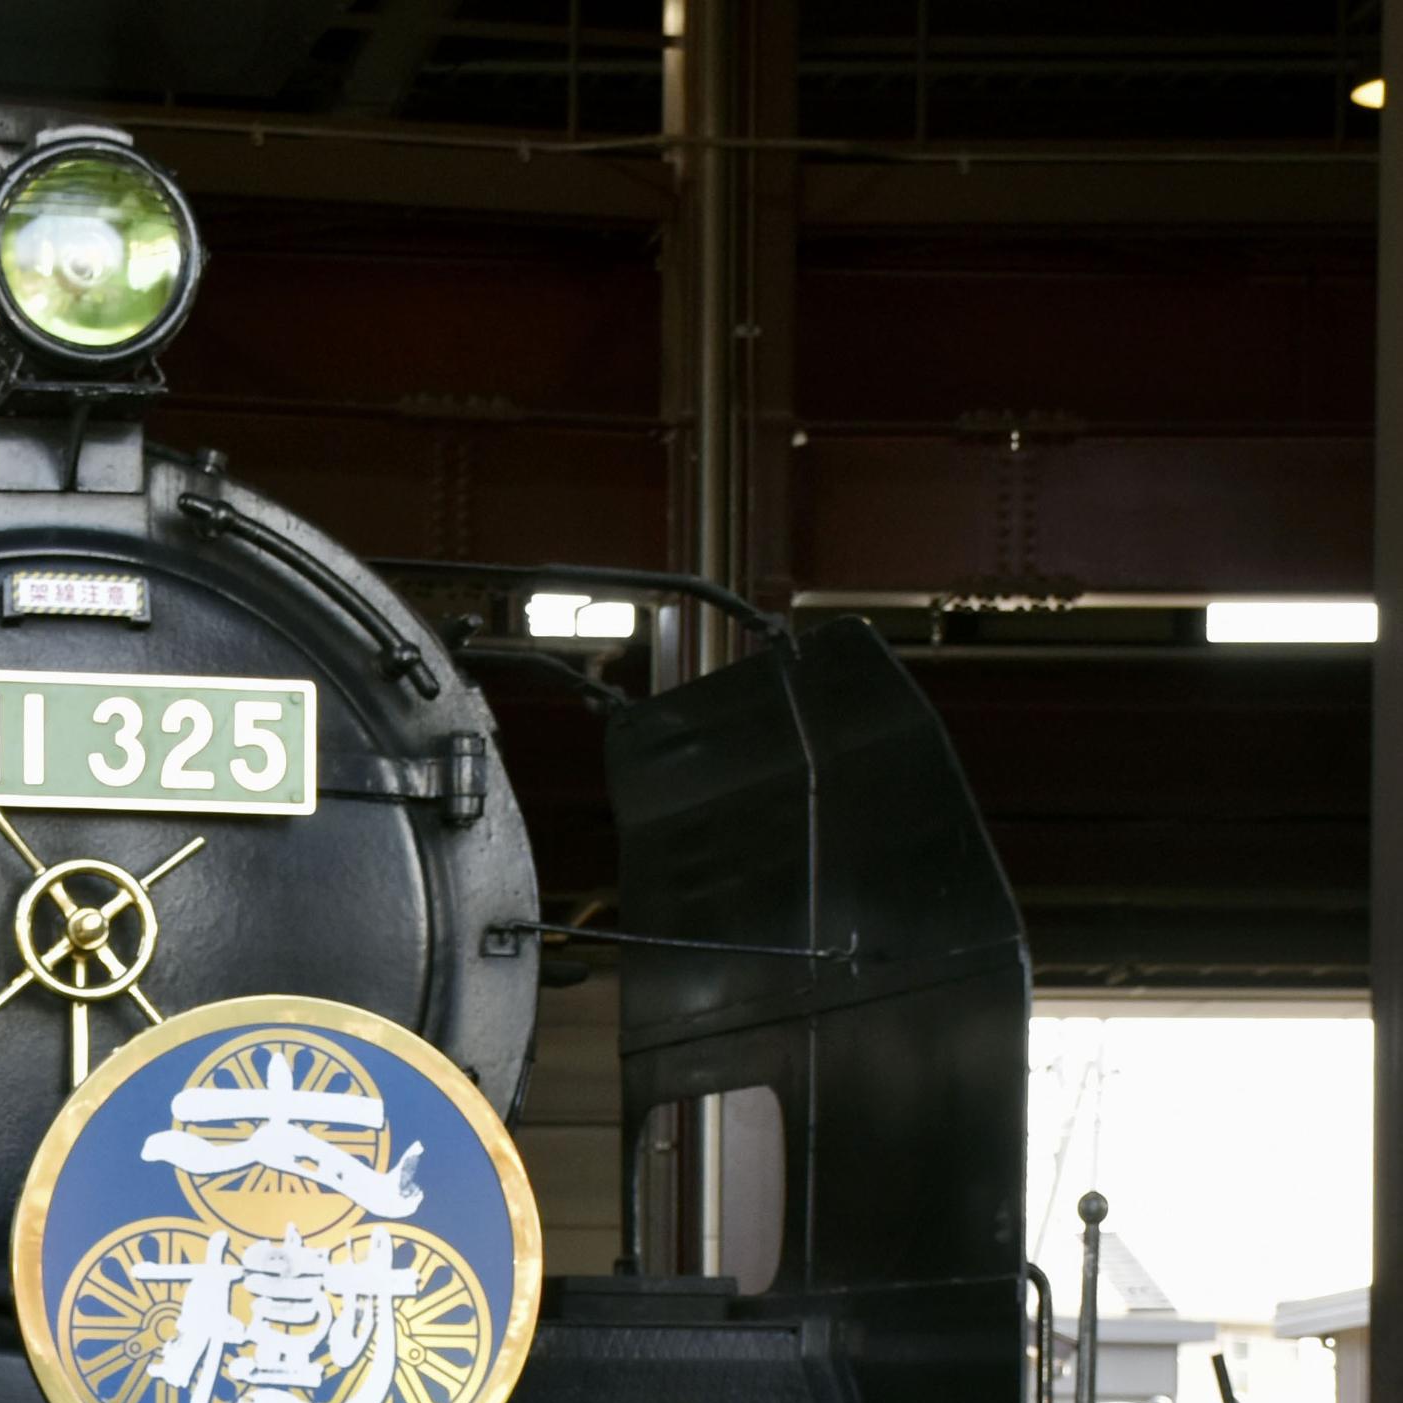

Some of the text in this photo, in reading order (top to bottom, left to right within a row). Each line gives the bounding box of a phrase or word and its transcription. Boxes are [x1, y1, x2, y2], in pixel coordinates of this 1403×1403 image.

[29, 583, 125, 605] 架線注意
[88, 697, 287, 792] 325
